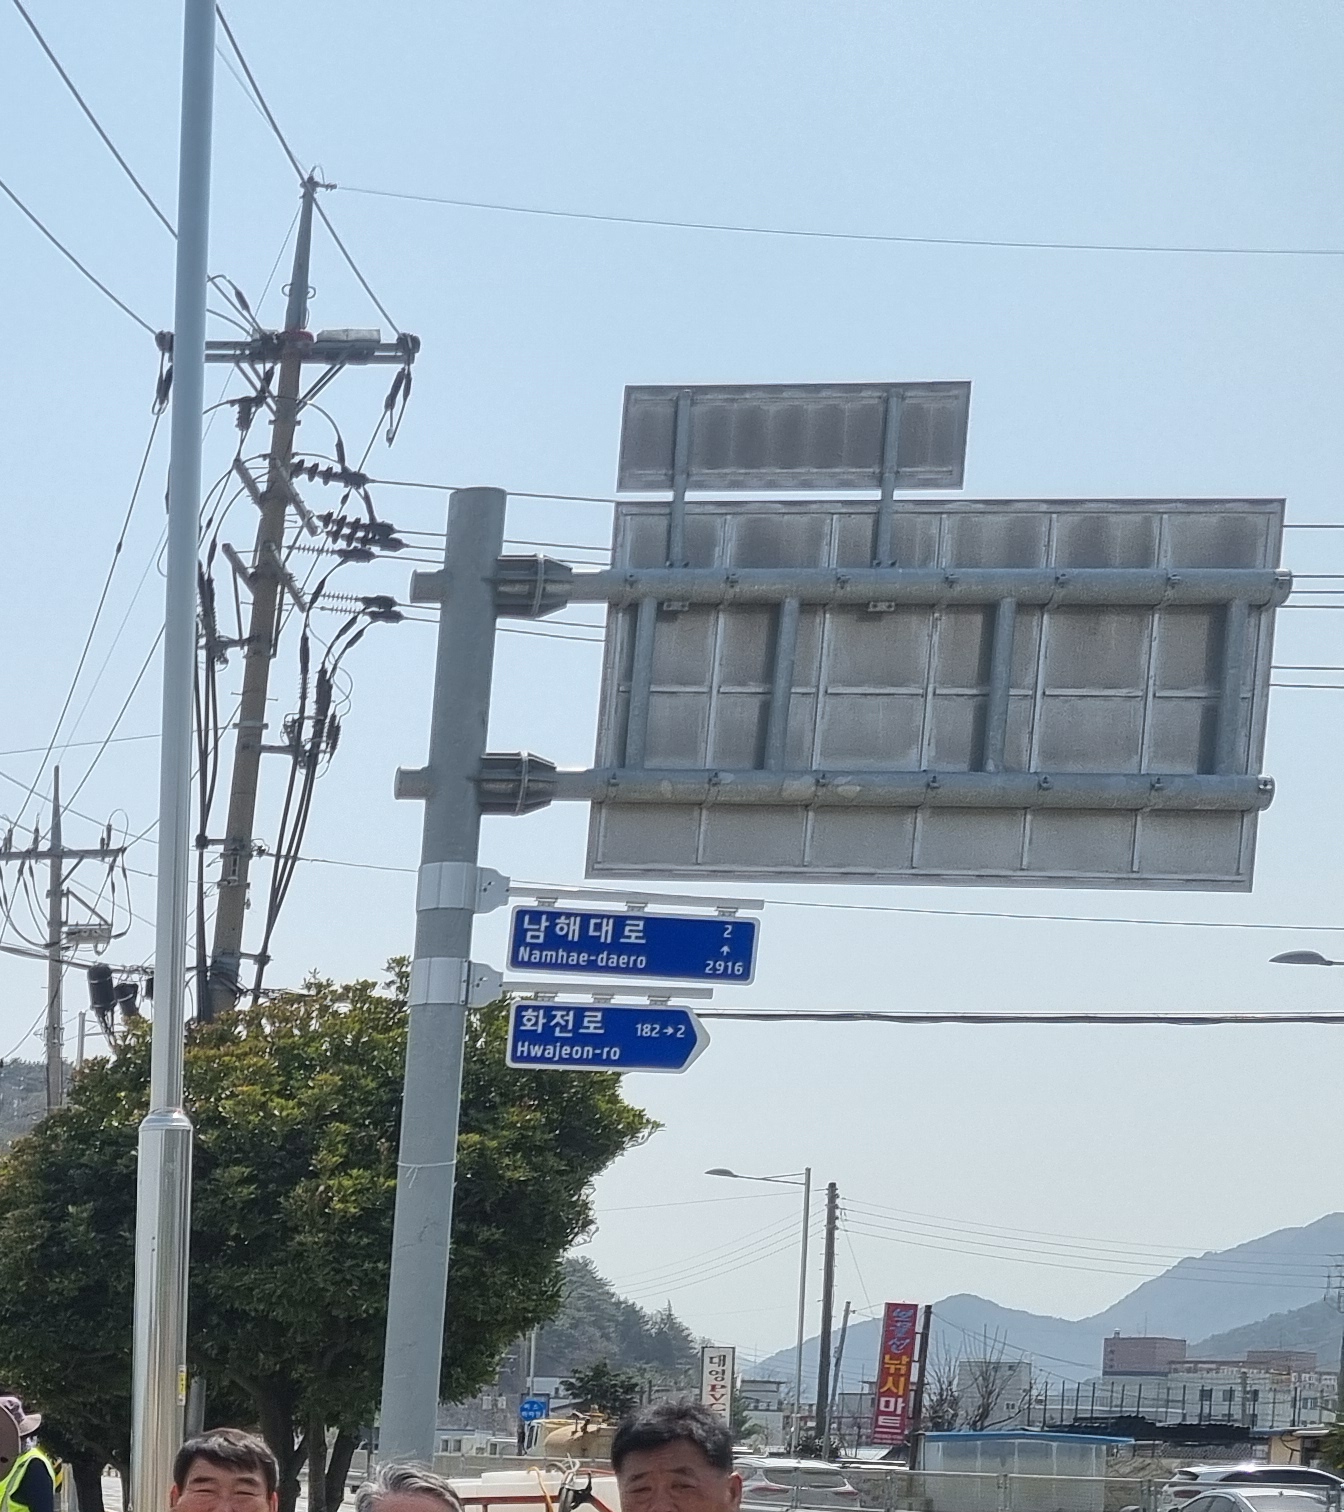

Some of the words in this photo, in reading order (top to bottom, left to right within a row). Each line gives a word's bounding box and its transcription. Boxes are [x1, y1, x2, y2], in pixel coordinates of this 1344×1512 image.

[522, 914, 647, 944] 남해대로
[723, 924, 733, 938] 2
[518, 946, 647, 969] Namhae-daero
[704, 960, 744, 975] 2916
[519, 1009, 605, 1037] 화전로
[635, 1023, 660, 1038] 182
[676, 1024, 685, 1038] 2
[516, 1041, 620, 1061] Hwajeon-ro
[708, 1354, 727, 1418] 대영PVC
[874, 1354, 910, 1433] 낚시마트
